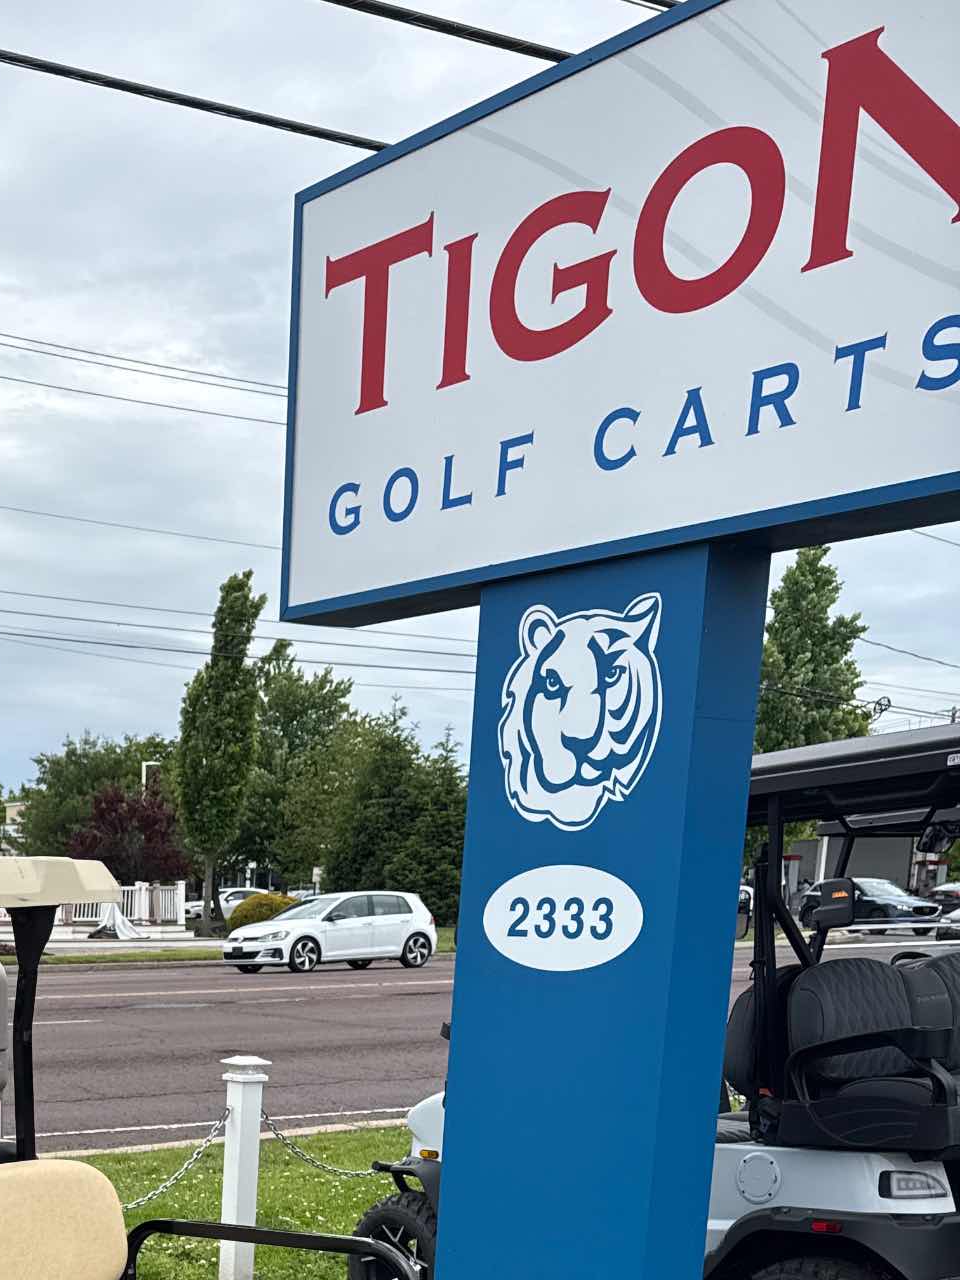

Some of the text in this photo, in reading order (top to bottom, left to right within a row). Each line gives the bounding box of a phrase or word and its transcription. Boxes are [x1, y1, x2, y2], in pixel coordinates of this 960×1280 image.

[325, 26, 960, 415] TIGON
[328, 313, 960, 535] GOLF CARTS
[507, 896, 614, 941] 2333
